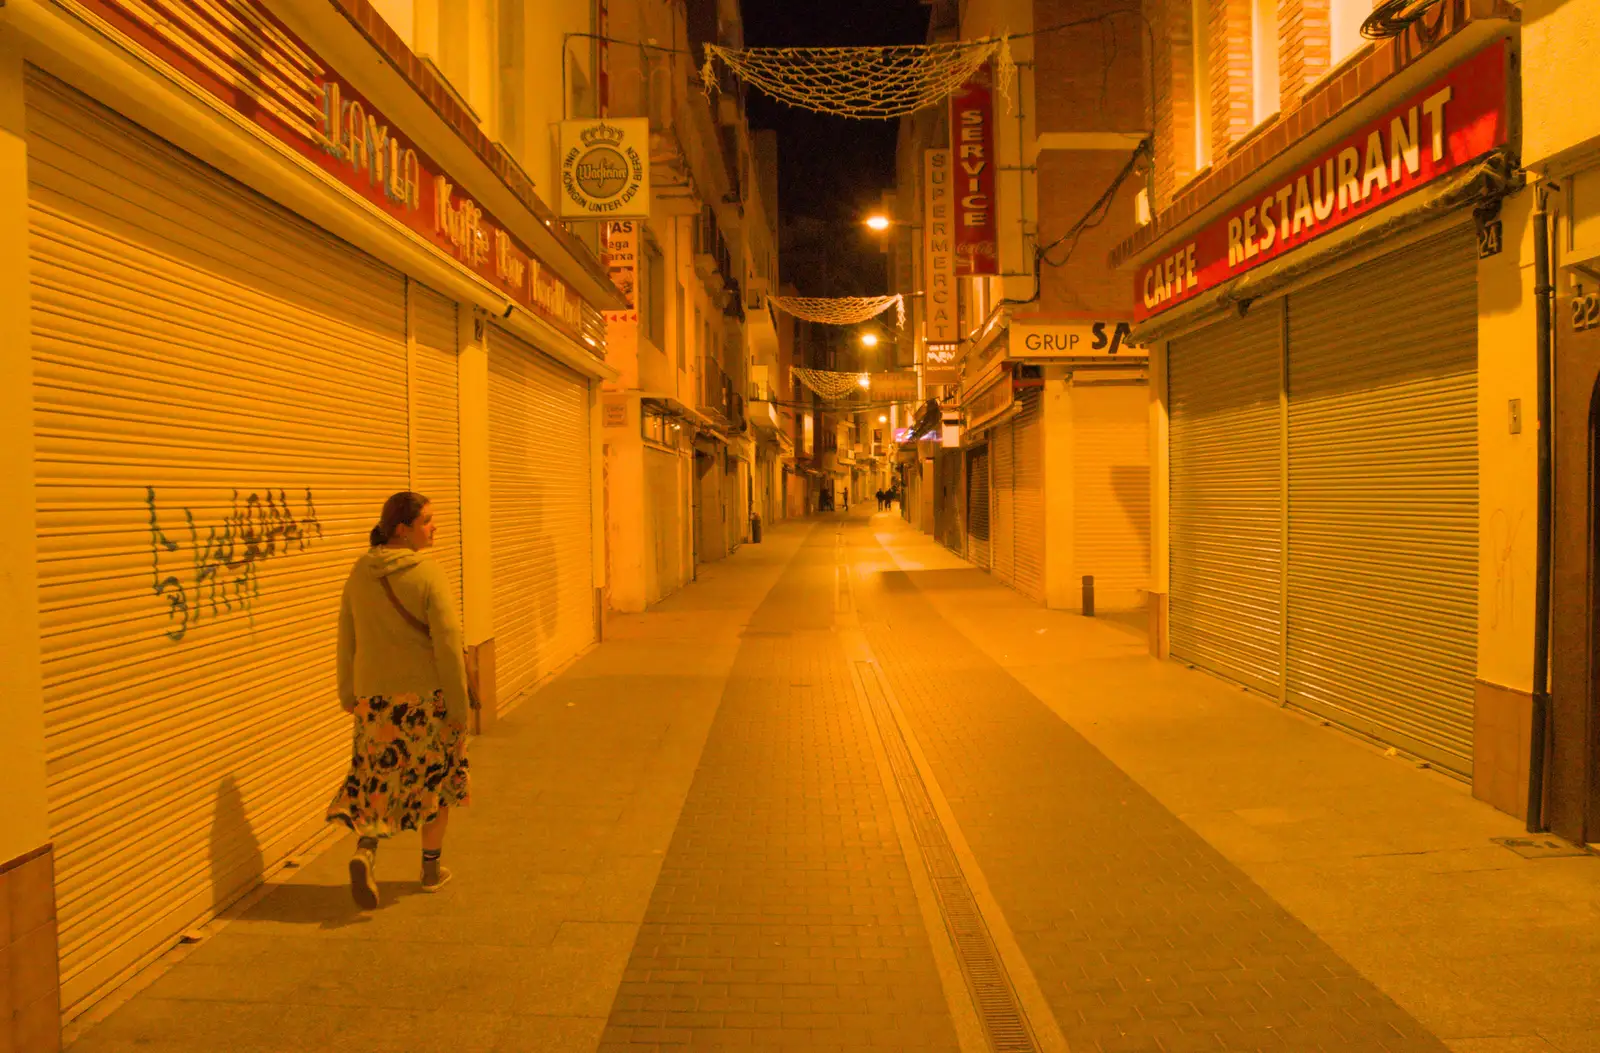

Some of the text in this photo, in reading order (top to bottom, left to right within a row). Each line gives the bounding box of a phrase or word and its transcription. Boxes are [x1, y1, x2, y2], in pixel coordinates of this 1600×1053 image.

[324, 82, 419, 213] LAYLA
[563, 146, 643, 213] EINE KÖNIGIN UNTER DEN BIEREN
[961, 110, 988, 226] SERVICE
[1143, 86, 1452, 308] CAFFE RESTAURANT
[608, 241, 629, 250] ega
[610, 221, 633, 234] AS
[931, 153, 949, 338] SUPERMERCAT
[1480, 224, 1497, 256] 24
[608, 253, 634, 261] arxa
[1571, 293, 1599, 330] 22
[1025, 322, 1149, 354] GRUP SA
